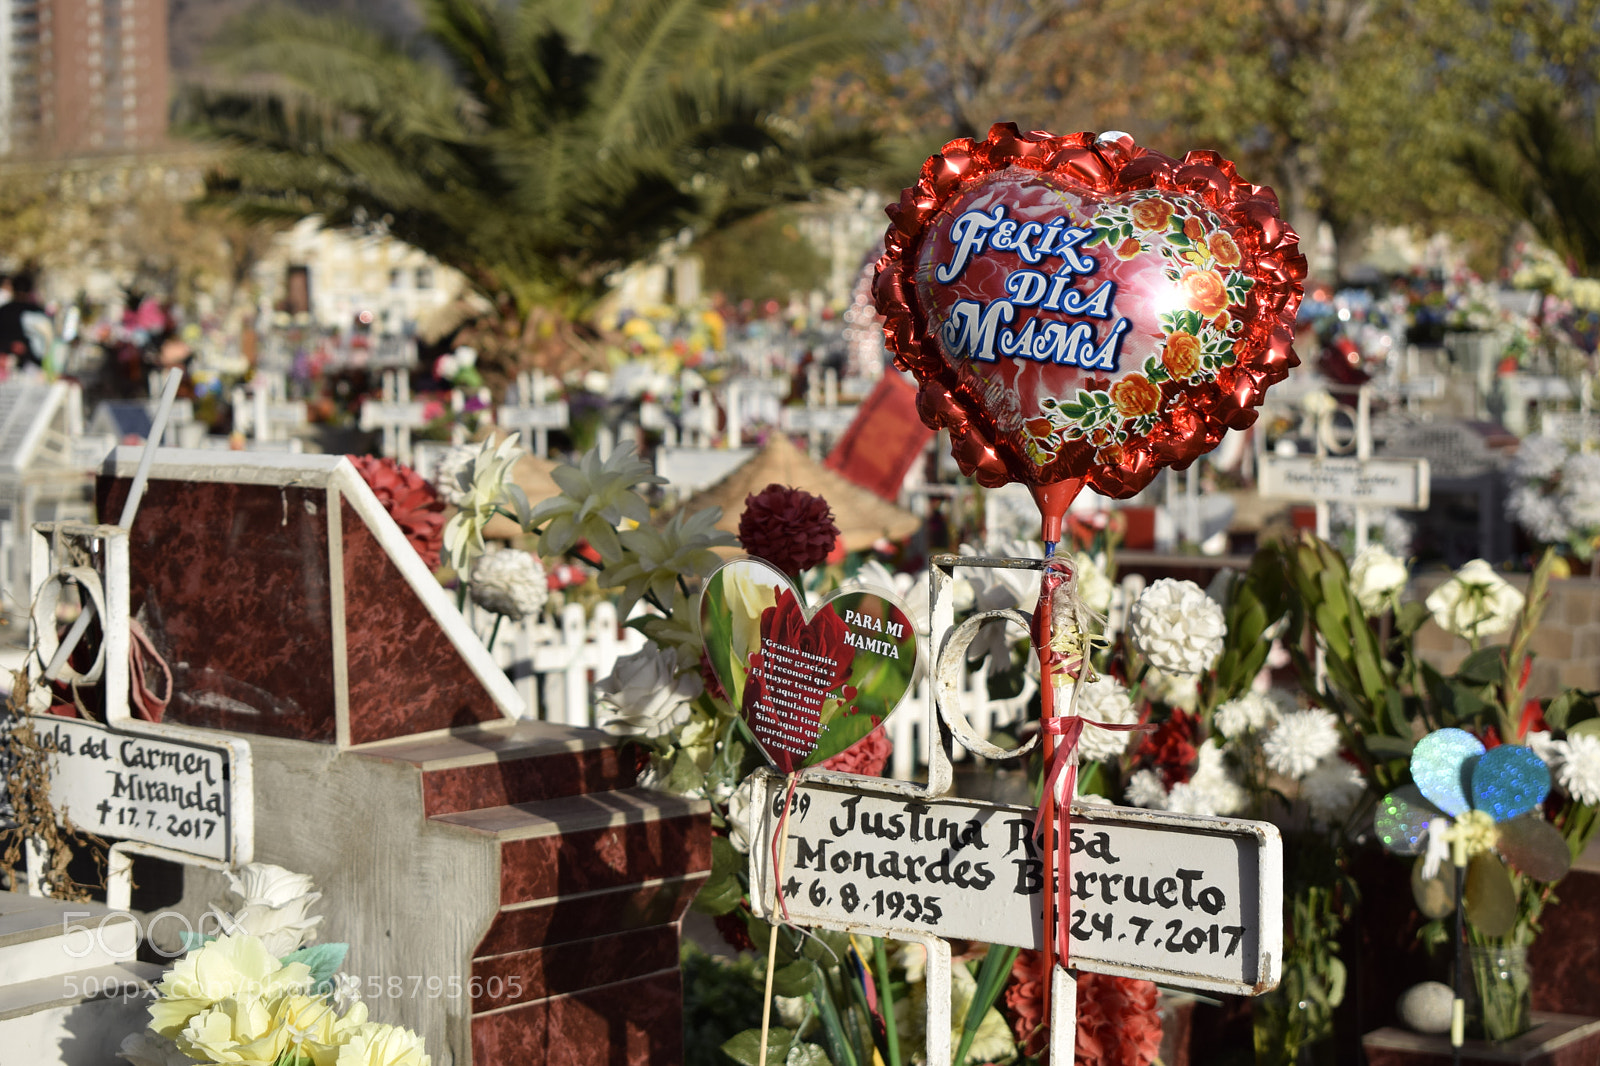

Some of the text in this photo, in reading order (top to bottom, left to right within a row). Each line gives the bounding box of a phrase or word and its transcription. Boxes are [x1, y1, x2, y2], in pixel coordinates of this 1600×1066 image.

[1005, 265, 1113, 318] DÍA
[942, 297, 1128, 370] MAMÁ
[844, 610, 904, 638] PARA MI
[801, 651, 838, 667] mamita
[843, 631, 900, 659] MAMITA
[794, 660, 828, 675] gracias
[752, 667, 838, 699] El mayor tesoro no
[776, 687, 802, 699] aquel
[803, 696, 821, 705] que
[813, 677, 832, 687] que
[762, 694, 820, 717] acumulamos
[776, 709, 788, 717] en
[789, 712, 798, 721] la
[755, 712, 821, 738] Sino aquel que
[755, 724, 819, 749] guardamos en
[80, 736, 112, 761] del
[120, 739, 216, 786] Carmen
[105, 769, 225, 817] Miranda
[830, 796, 989, 851] Justina
[787, 834, 996, 891] Monardes
